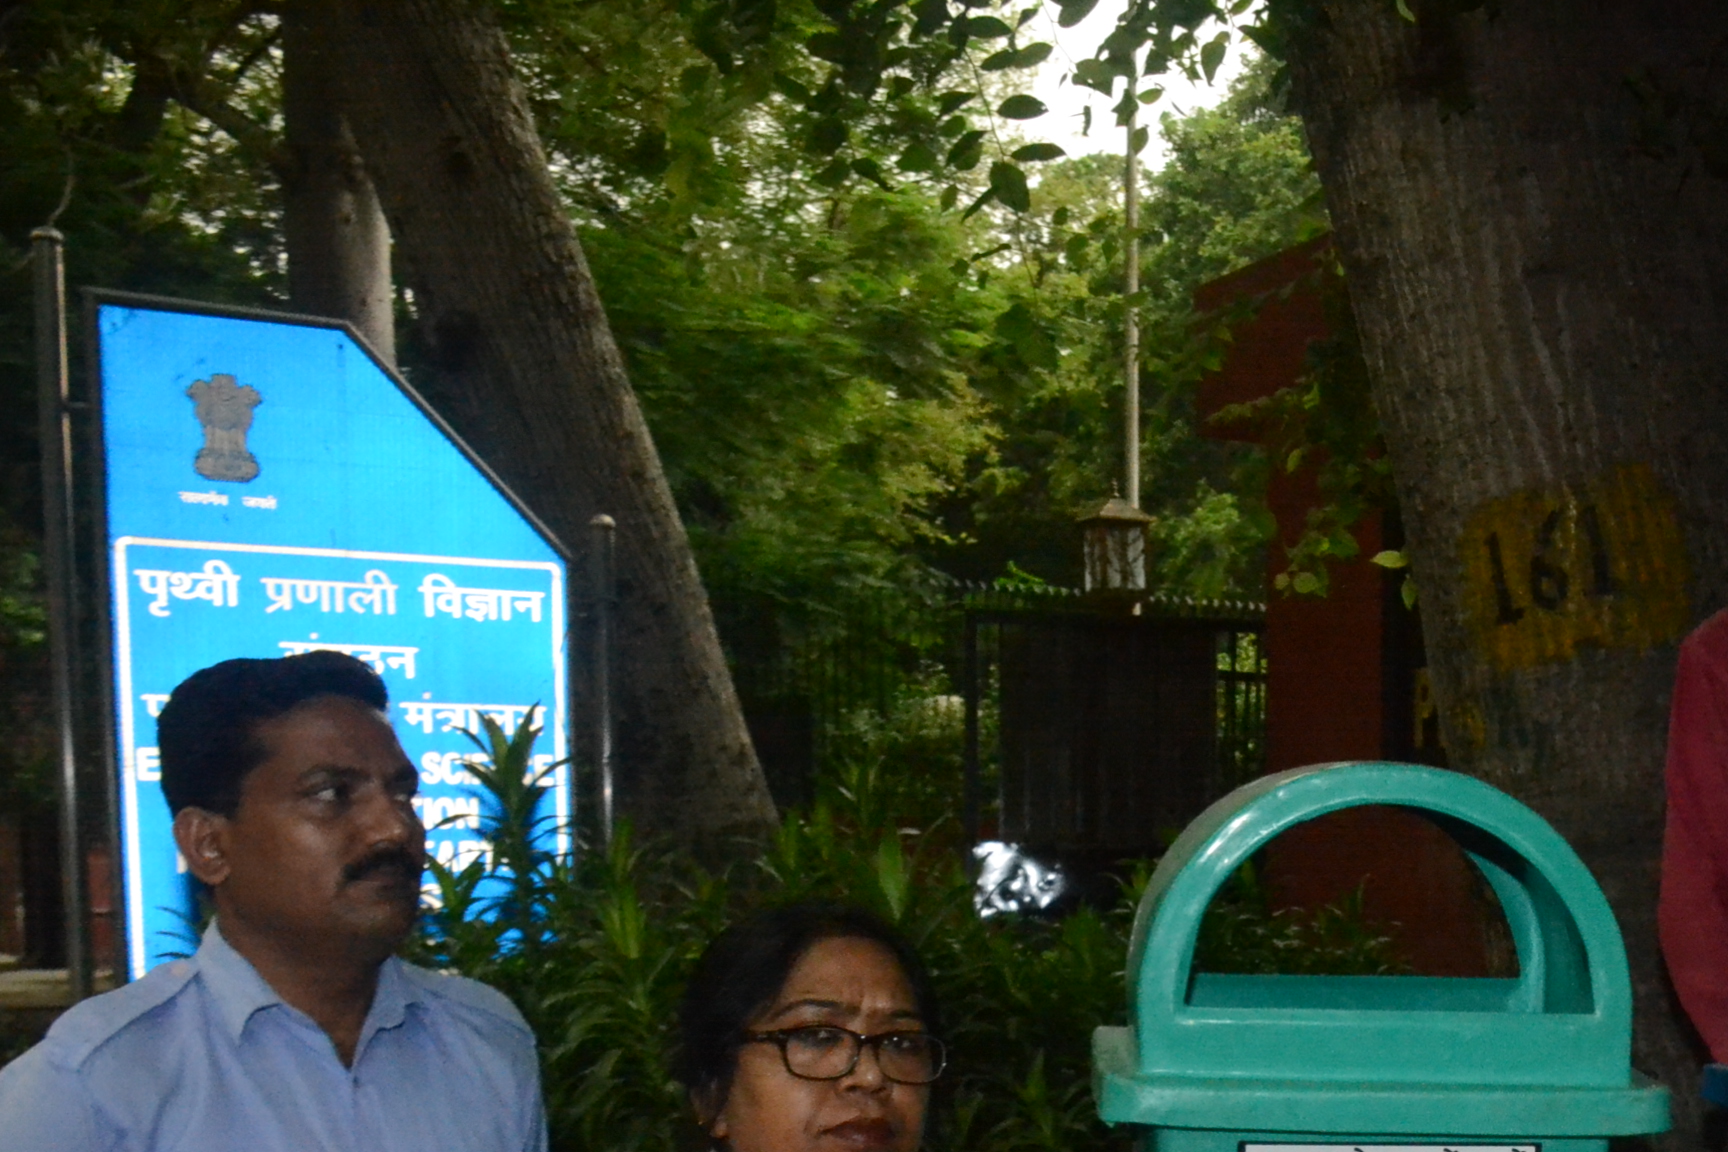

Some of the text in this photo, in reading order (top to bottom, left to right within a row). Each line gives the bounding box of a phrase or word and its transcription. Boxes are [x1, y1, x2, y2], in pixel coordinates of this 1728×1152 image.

[133, 558, 547, 622] पृथ्वी प्रणाली विज्ञान
